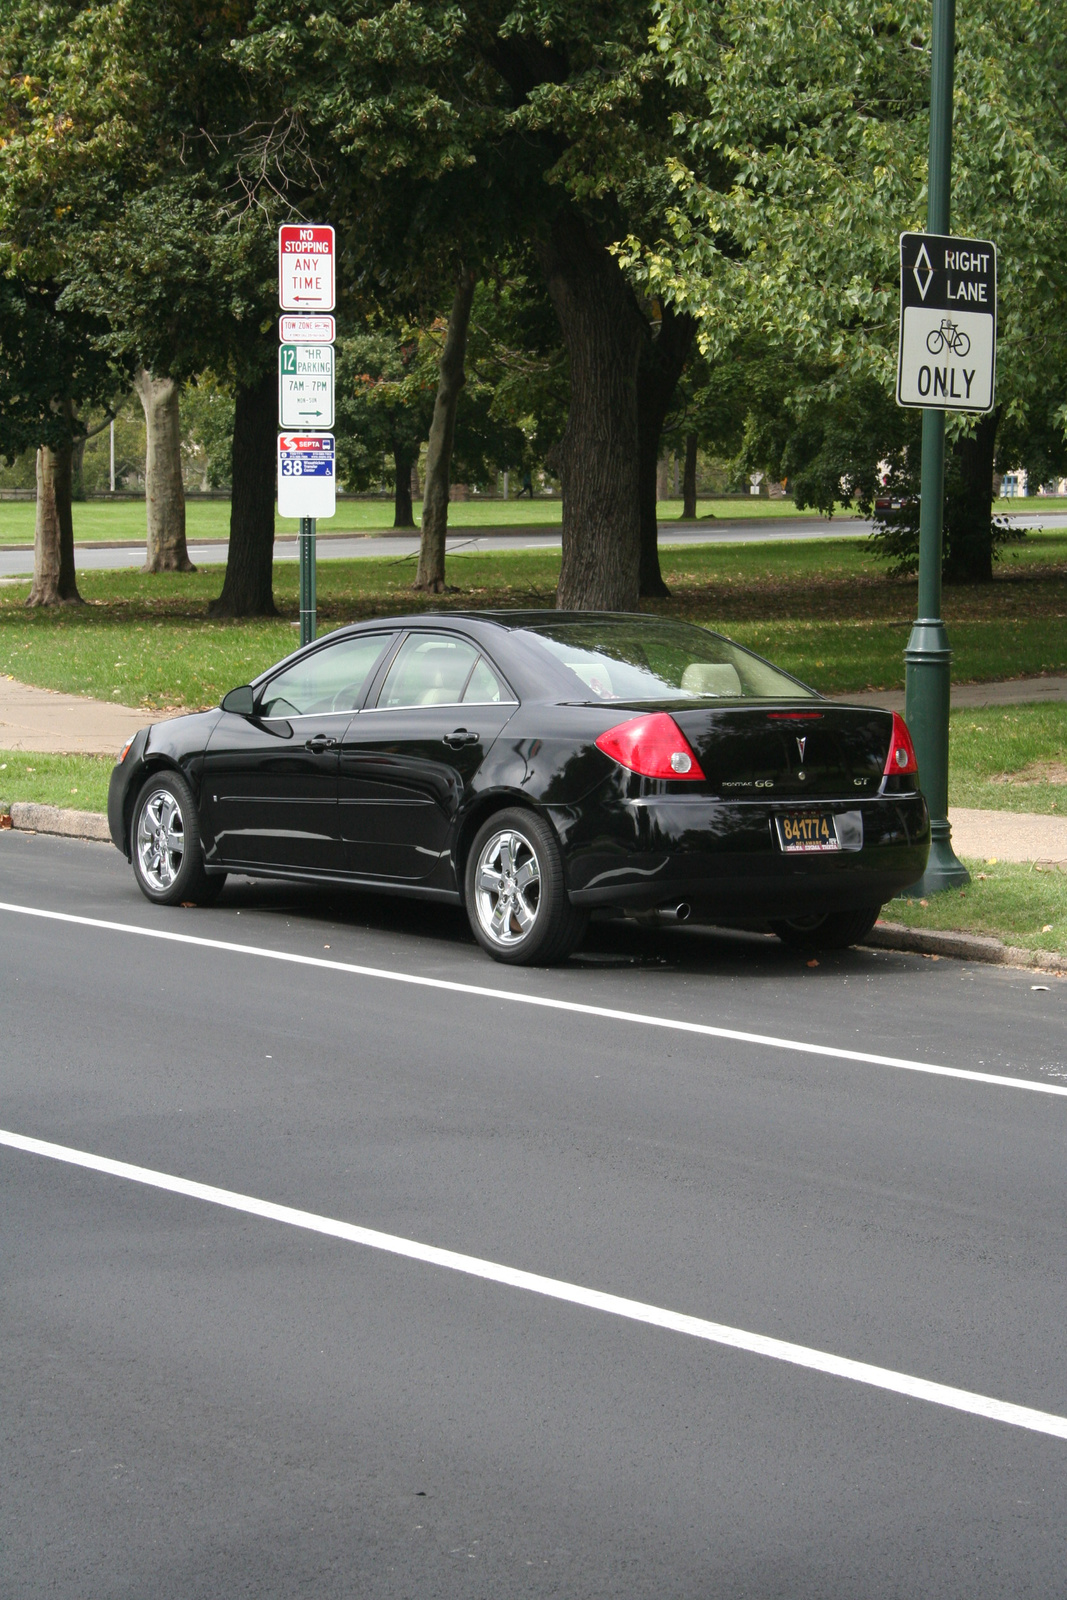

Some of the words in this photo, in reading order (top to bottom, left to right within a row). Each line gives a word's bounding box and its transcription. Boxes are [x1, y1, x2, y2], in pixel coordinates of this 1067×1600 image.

[299, 229, 313, 241] NO
[284, 241, 329, 253] STOPPING
[294, 258, 319, 271] ANY
[944, 249, 990, 274] RIGHT
[292, 276, 322, 290] TIME
[946, 279, 988, 303] LANE
[285, 321, 296, 330] TOW
[298, 321, 313, 330] ZONE
[283, 349, 295, 371] 12
[308, 349, 322, 360] HR
[297, 361, 331, 373] PARKING
[917, 364, 976, 399] ONLY
[298, 440, 320, 448] SEPTA
[283, 460, 303, 476] 38
[754, 779, 774, 788] G6
[853, 777, 870, 786] GT
[783, 818, 830, 840] 841774
